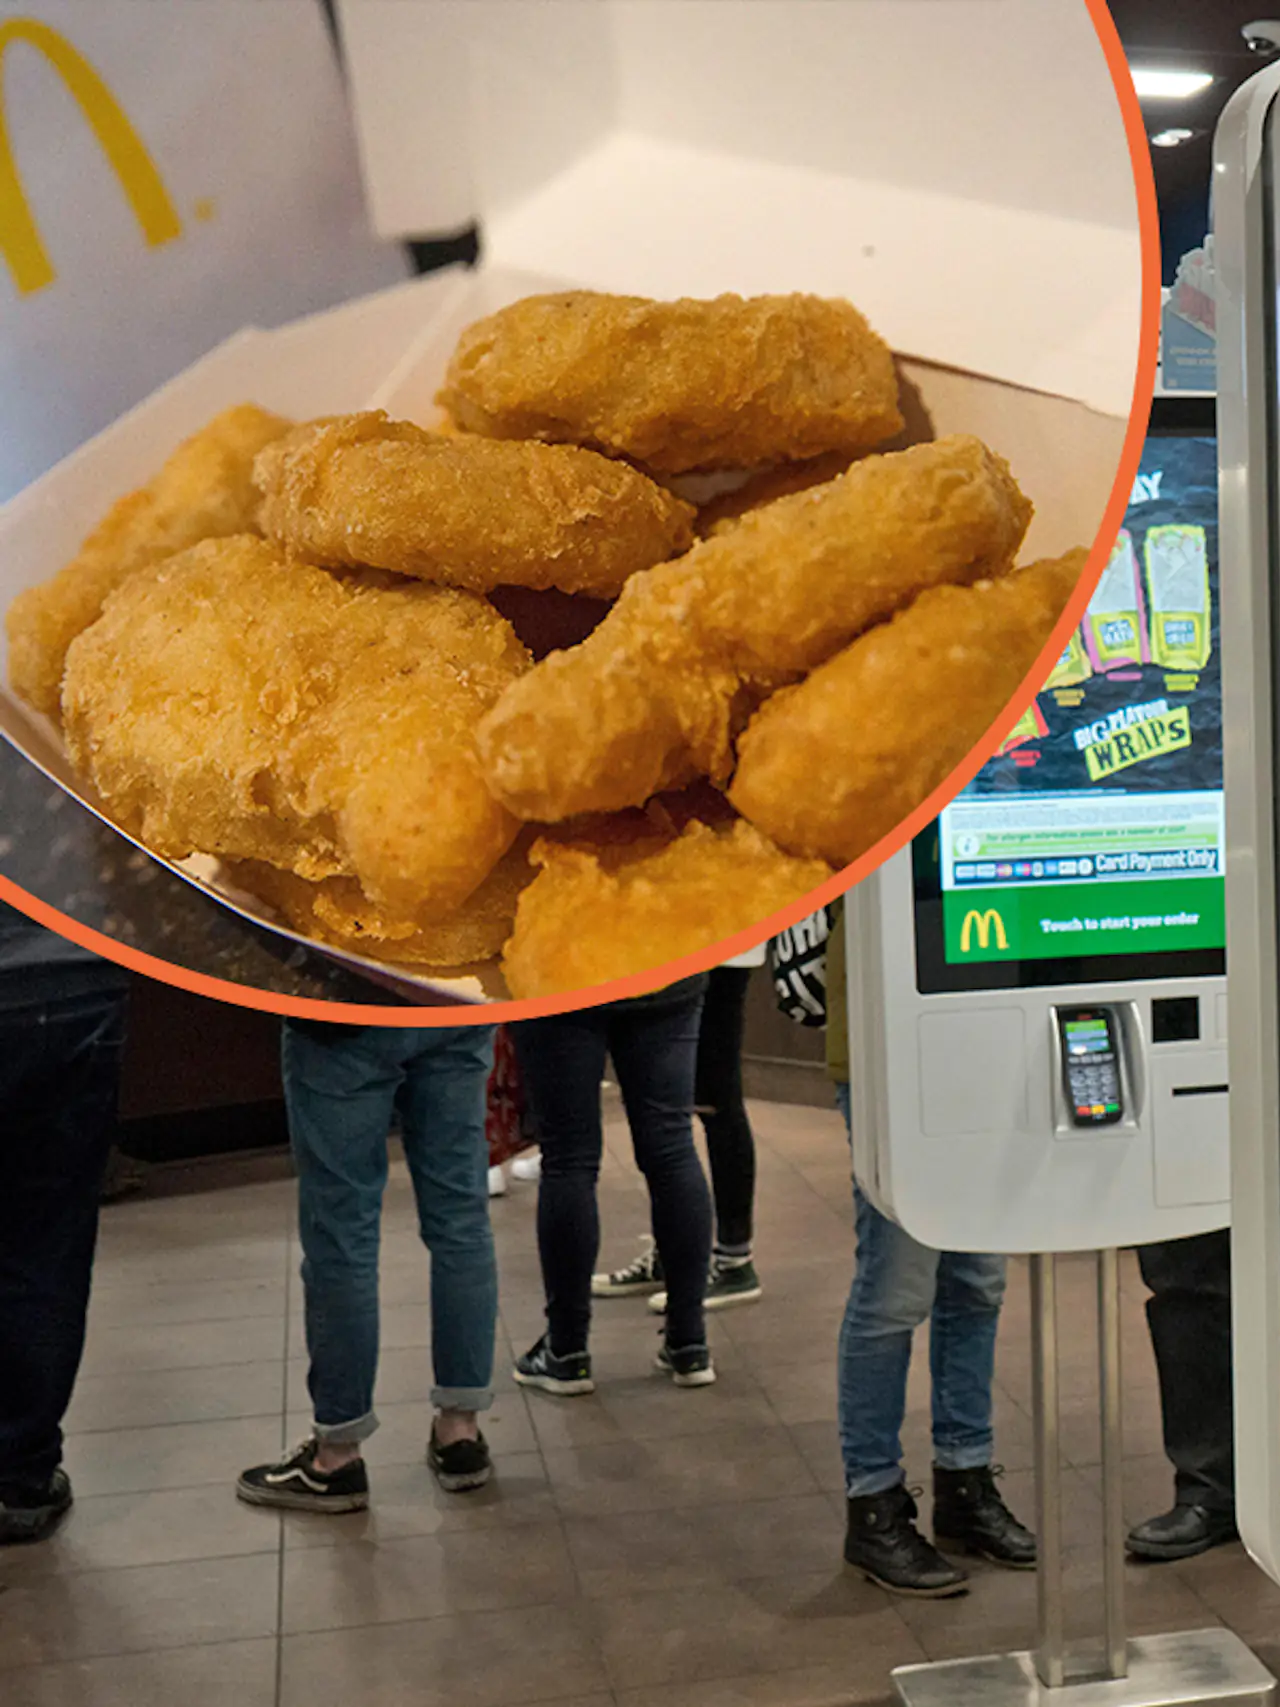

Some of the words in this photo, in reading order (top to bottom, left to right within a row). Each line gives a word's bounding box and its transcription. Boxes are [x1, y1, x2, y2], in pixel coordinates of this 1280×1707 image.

[1092, 718, 1186, 771] WRAPS
[1096, 852, 1128, 872] Card
[1130, 850, 1187, 872] Payment
[1187, 848, 1216, 869] Only
[1040, 916, 1083, 933] Touch
[1084, 916, 1098, 930] to
[1099, 915, 1130, 930] start
[1130, 915, 1163, 931] your
[1163, 911, 1200, 926] order
